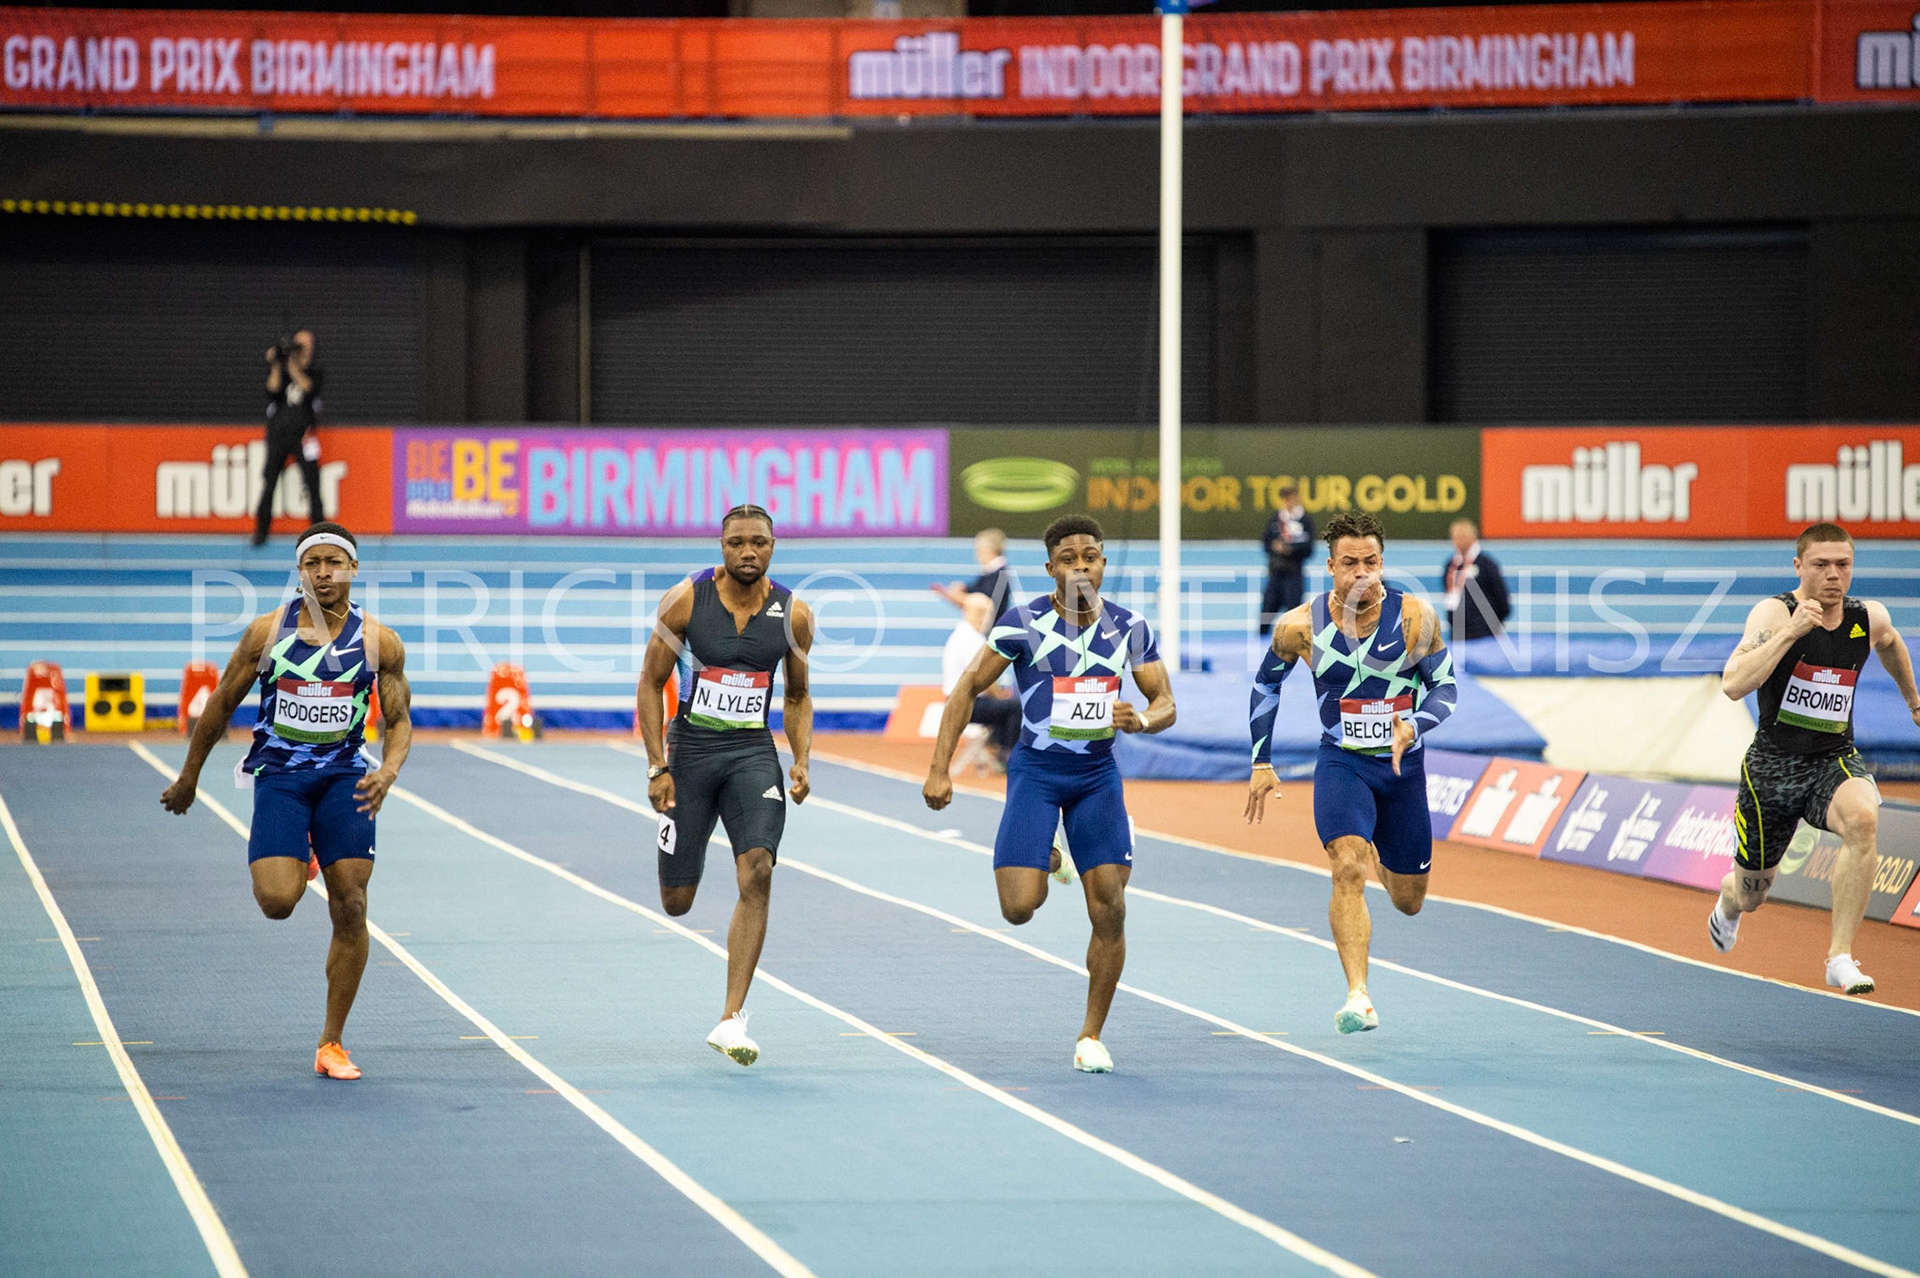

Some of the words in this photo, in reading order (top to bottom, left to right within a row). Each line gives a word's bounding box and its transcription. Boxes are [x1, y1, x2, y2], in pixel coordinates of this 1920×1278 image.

[3, 36, 140, 92] GRAND
[150, 38, 242, 94] PRIX
[251, 40, 496, 98] BIRMINGHAM
[849, 31, 1011, 98] müller
[1019, 44, 1162, 97] INDOOR
[1309, 38, 1395, 94] PRIX
[1403, 32, 1635, 91] BIRMINGHAM
[452, 439, 518, 501] BE
[527, 446, 935, 528] BIRMINGHAM
[1354, 474, 1467, 512] GOLD
[1521, 441, 1698, 522] müller
[297, 682, 333, 697] müller
[721, 672, 755, 688] müller
[1074, 678, 1108, 693] müller
[1812, 669, 1842, 684] müller
[279, 698, 348, 724] RODGERS
[696, 686, 712, 708] N.
[717, 693, 763, 713] LYLES
[1070, 701, 1106, 720] AZU
[1361, 701, 1395, 714] müller
[1786, 685, 1851, 713] BROMBY
[1344, 721, 1394, 739] BELCH
[660, 824, 671, 846] 4
[1873, 855, 1914, 895] GOLD
